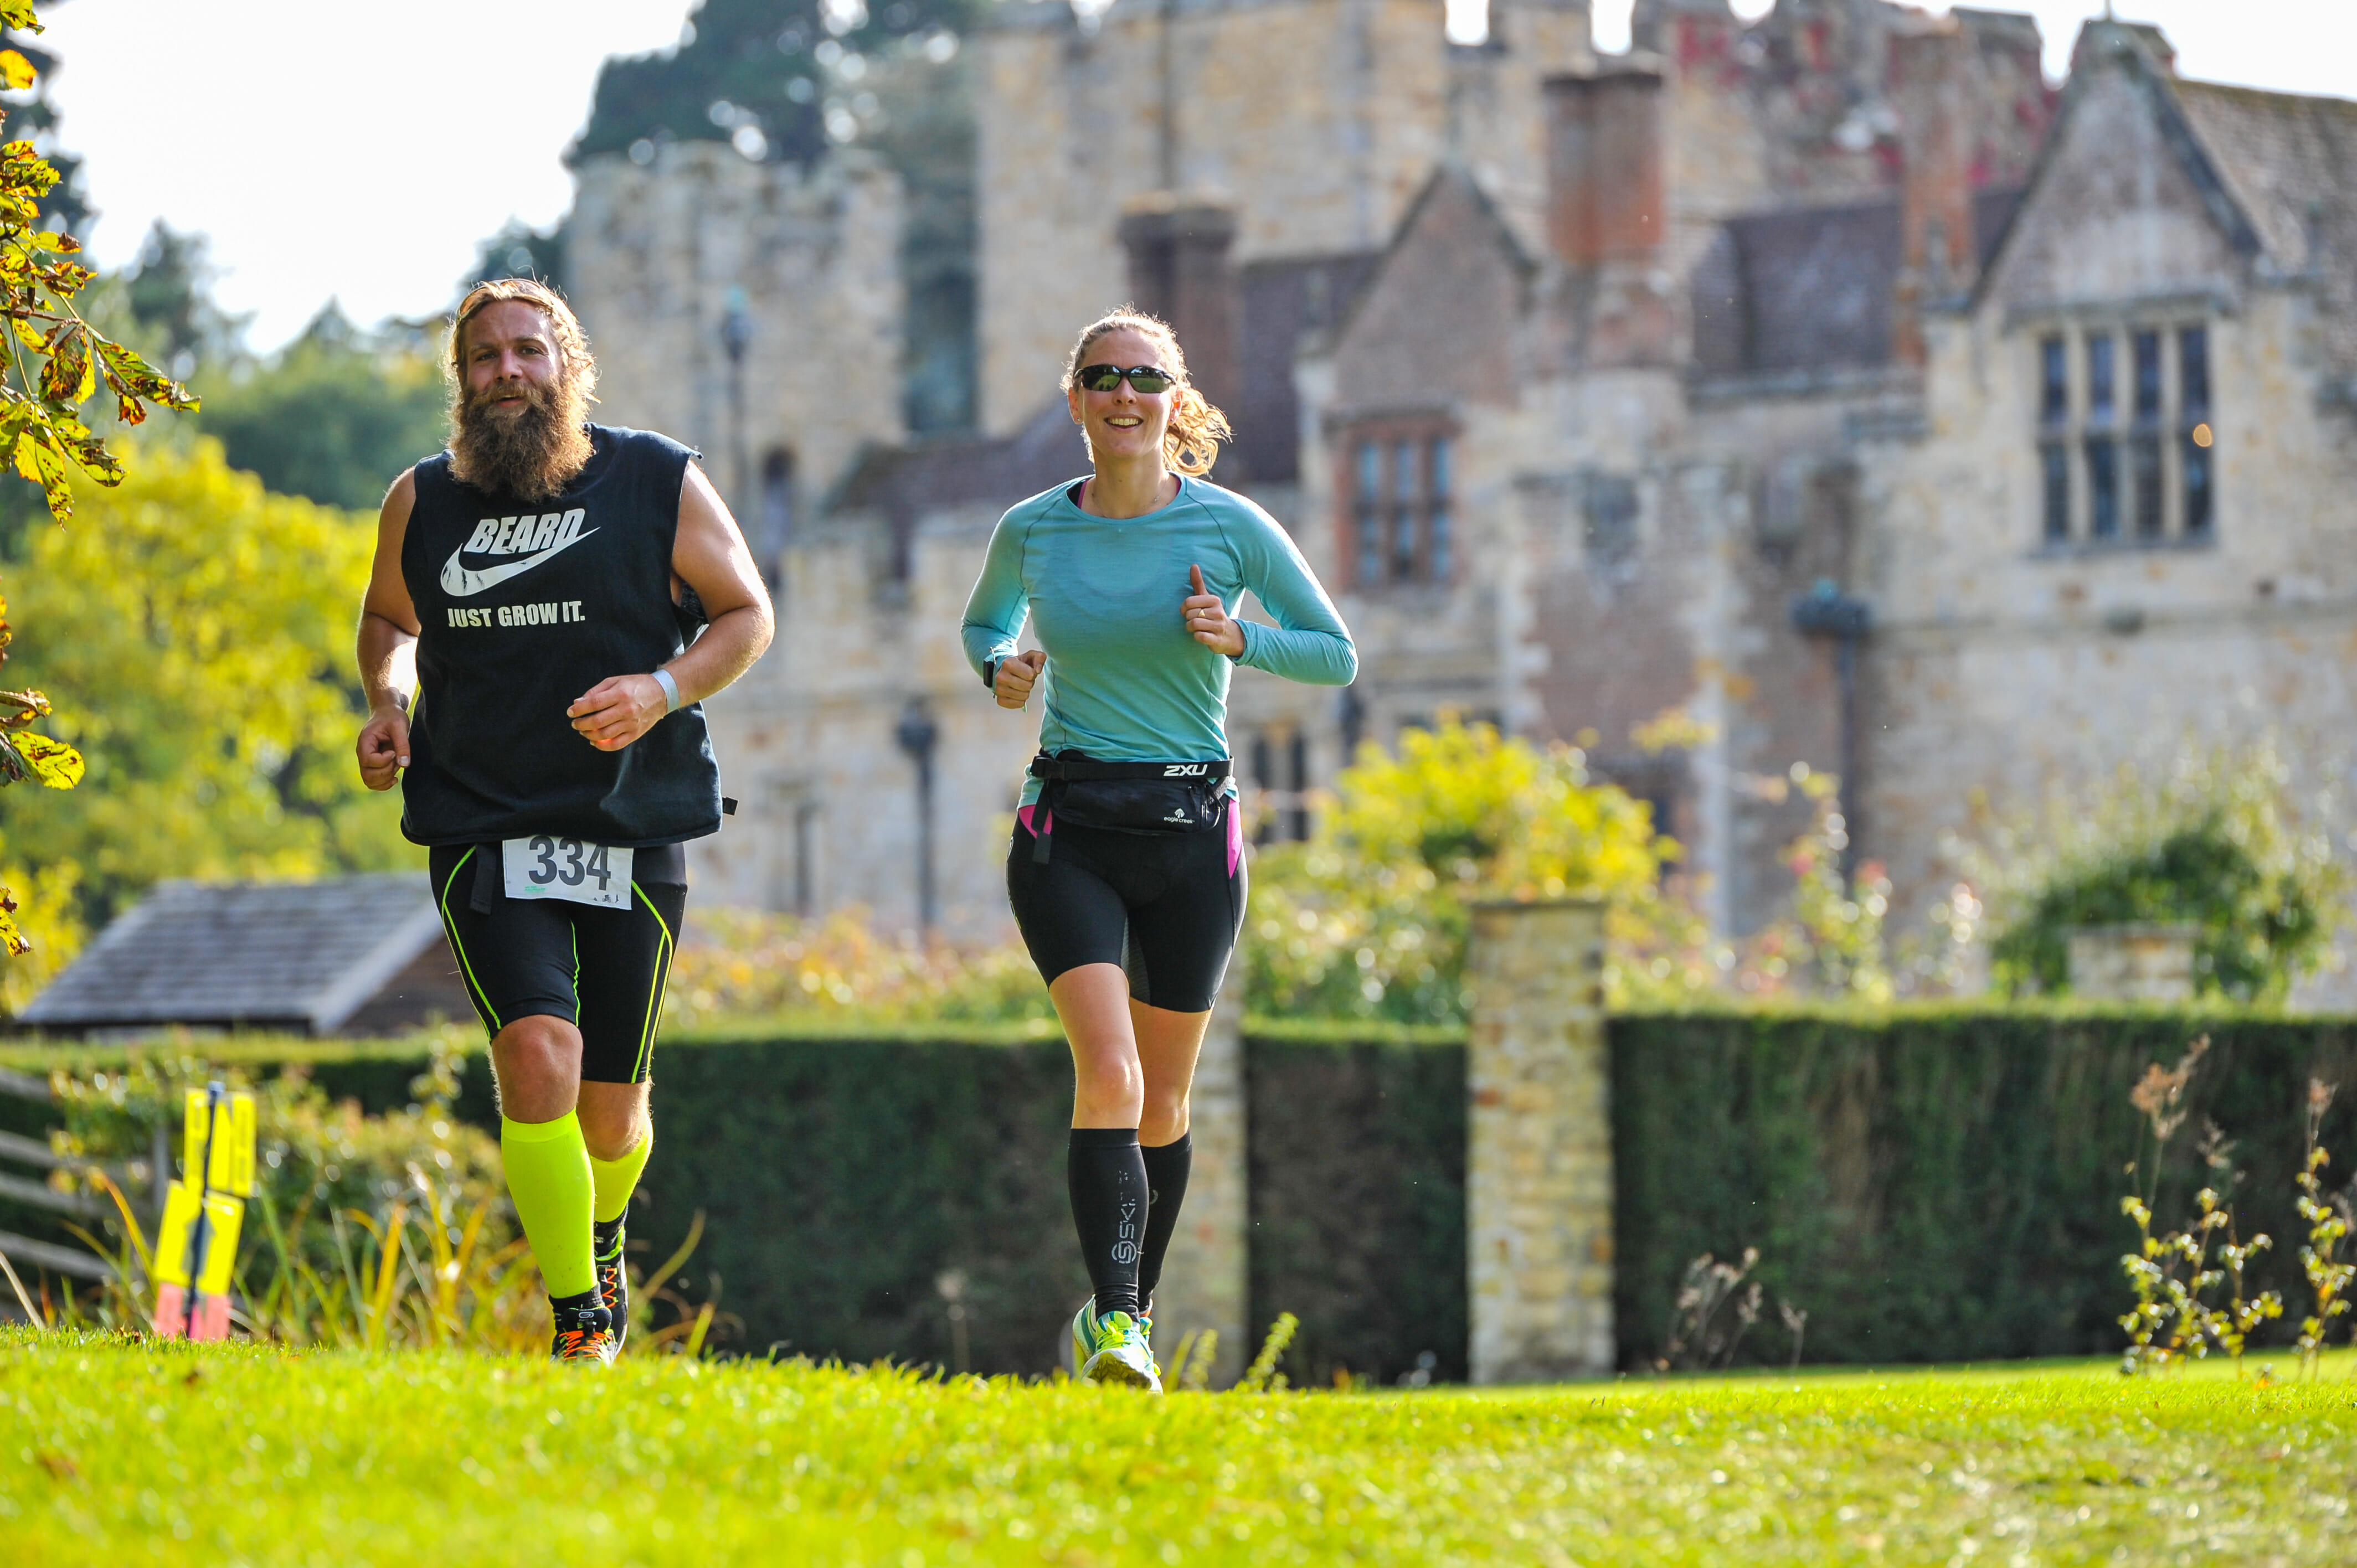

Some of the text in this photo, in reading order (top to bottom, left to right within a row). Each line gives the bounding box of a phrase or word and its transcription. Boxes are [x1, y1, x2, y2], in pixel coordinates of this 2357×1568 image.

[464, 508, 585, 554] BEARD
[447, 600, 585, 628] JUST GROW IT.
[1164, 764, 1208, 776] 2XU
[528, 835, 611, 891] 334
